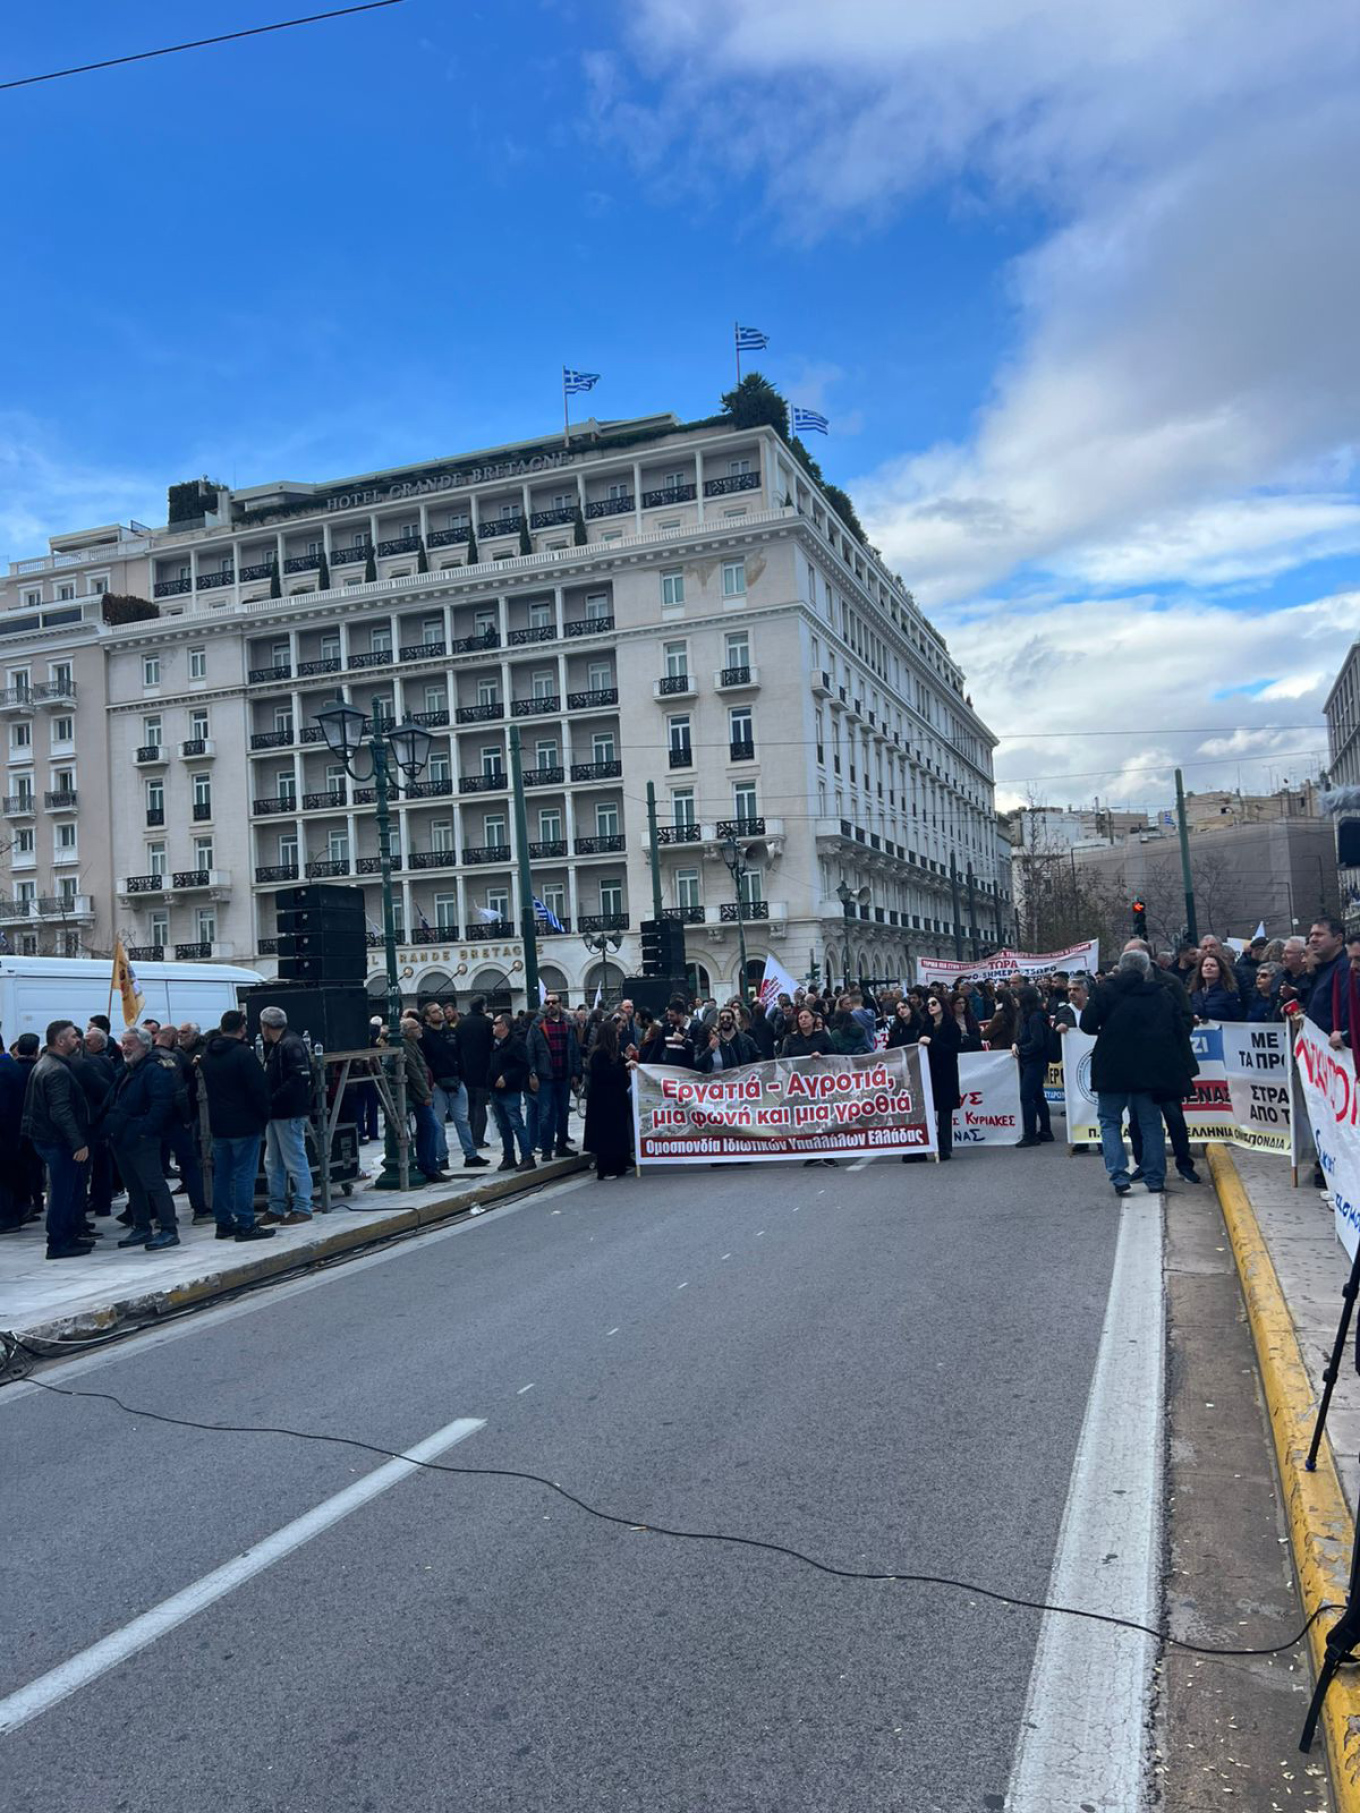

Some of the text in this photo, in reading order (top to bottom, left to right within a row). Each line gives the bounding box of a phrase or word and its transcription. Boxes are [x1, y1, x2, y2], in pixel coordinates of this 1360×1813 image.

[326, 451, 569, 511] HOTEL GRANDE BRETAGNE
[399, 944, 543, 964] RANDE BRETAGE
[1190, 1036, 1208, 1054] ΖΙ
[1250, 1032, 1279, 1049] ΜΕ
[1239, 1051, 1254, 1068] ΤΑ
[661, 1074, 761, 1103] Εργατιά
[788, 1062, 896, 1100] Αγροτιά,
[1250, 1084, 1290, 1105] ΣΤΡΑ
[653, 1092, 912, 1129] μια φωνή και μια γροθιά
[1250, 1104, 1278, 1123] ΑΠΟ
[645, 1128, 924, 1157] Ομοσπονδία Ιδιωτικών Υπαλλήλων Ελλάδας
